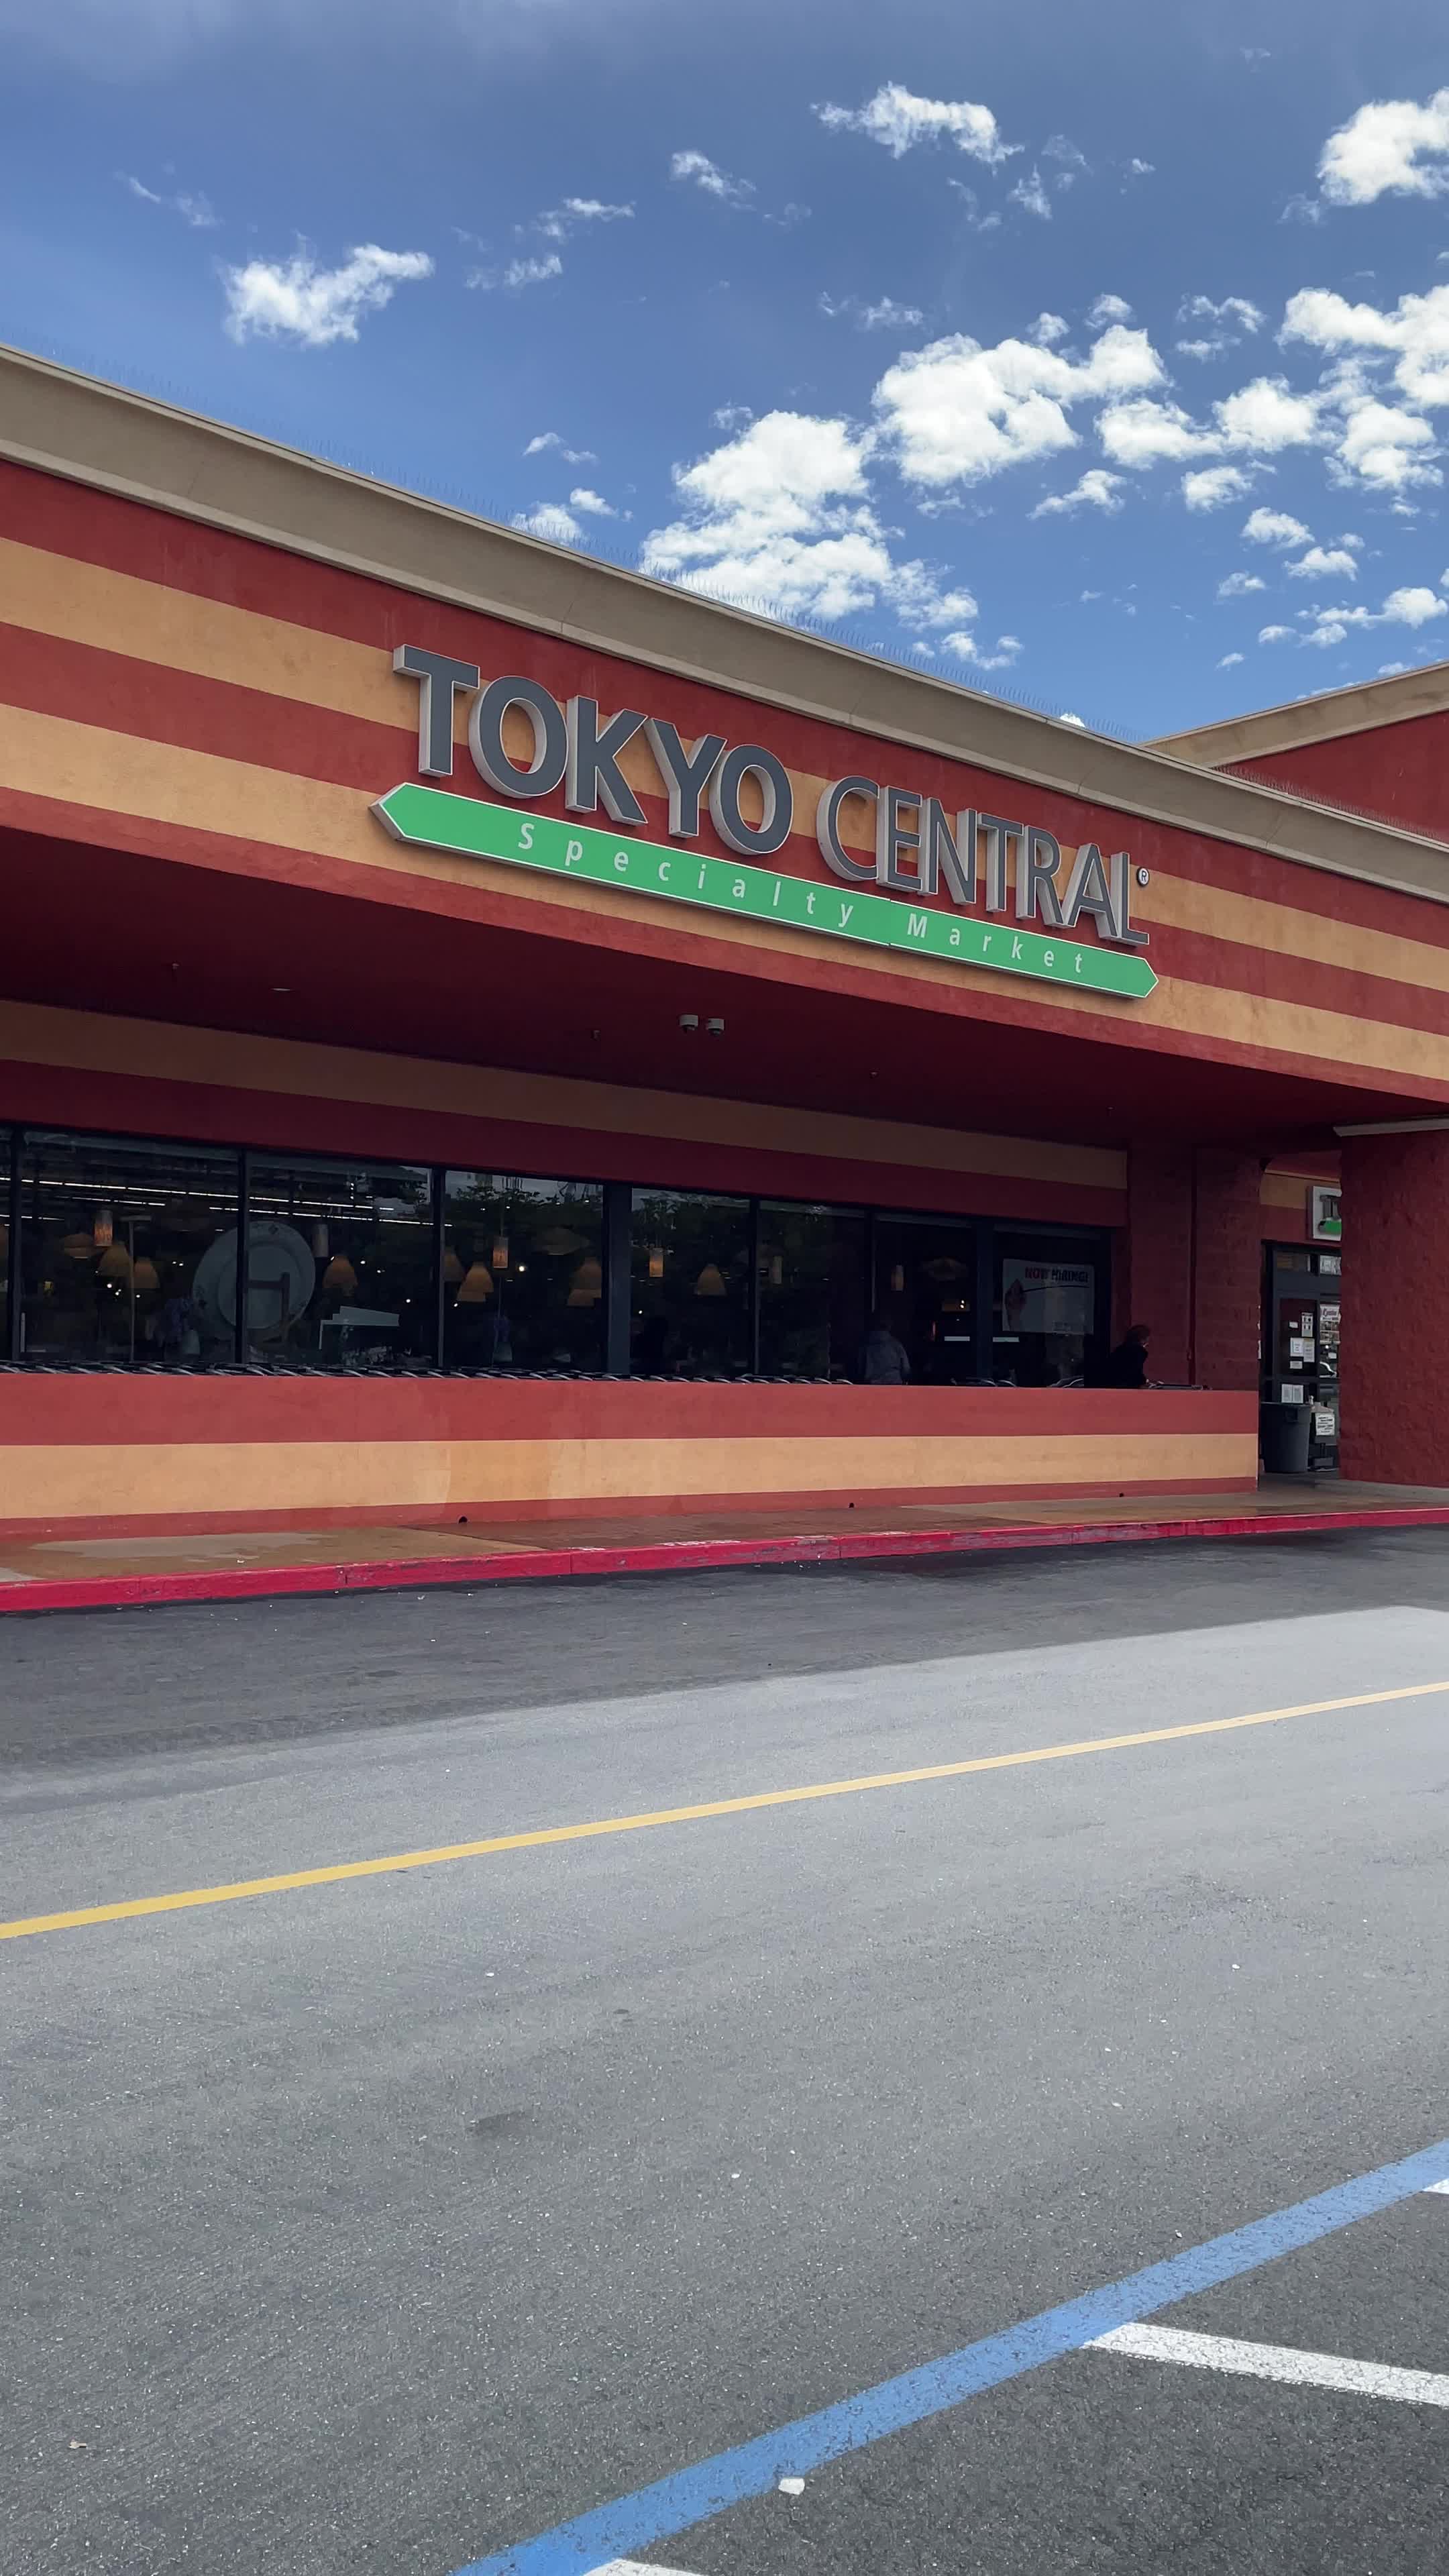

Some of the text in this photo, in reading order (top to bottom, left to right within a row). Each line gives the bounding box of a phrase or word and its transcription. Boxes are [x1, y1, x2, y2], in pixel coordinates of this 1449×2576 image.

[392, 643, 793, 856] TOKYO
[816, 775, 1149, 946] CENTRAL
[518, 822, 1083, 974] Specialty Market
